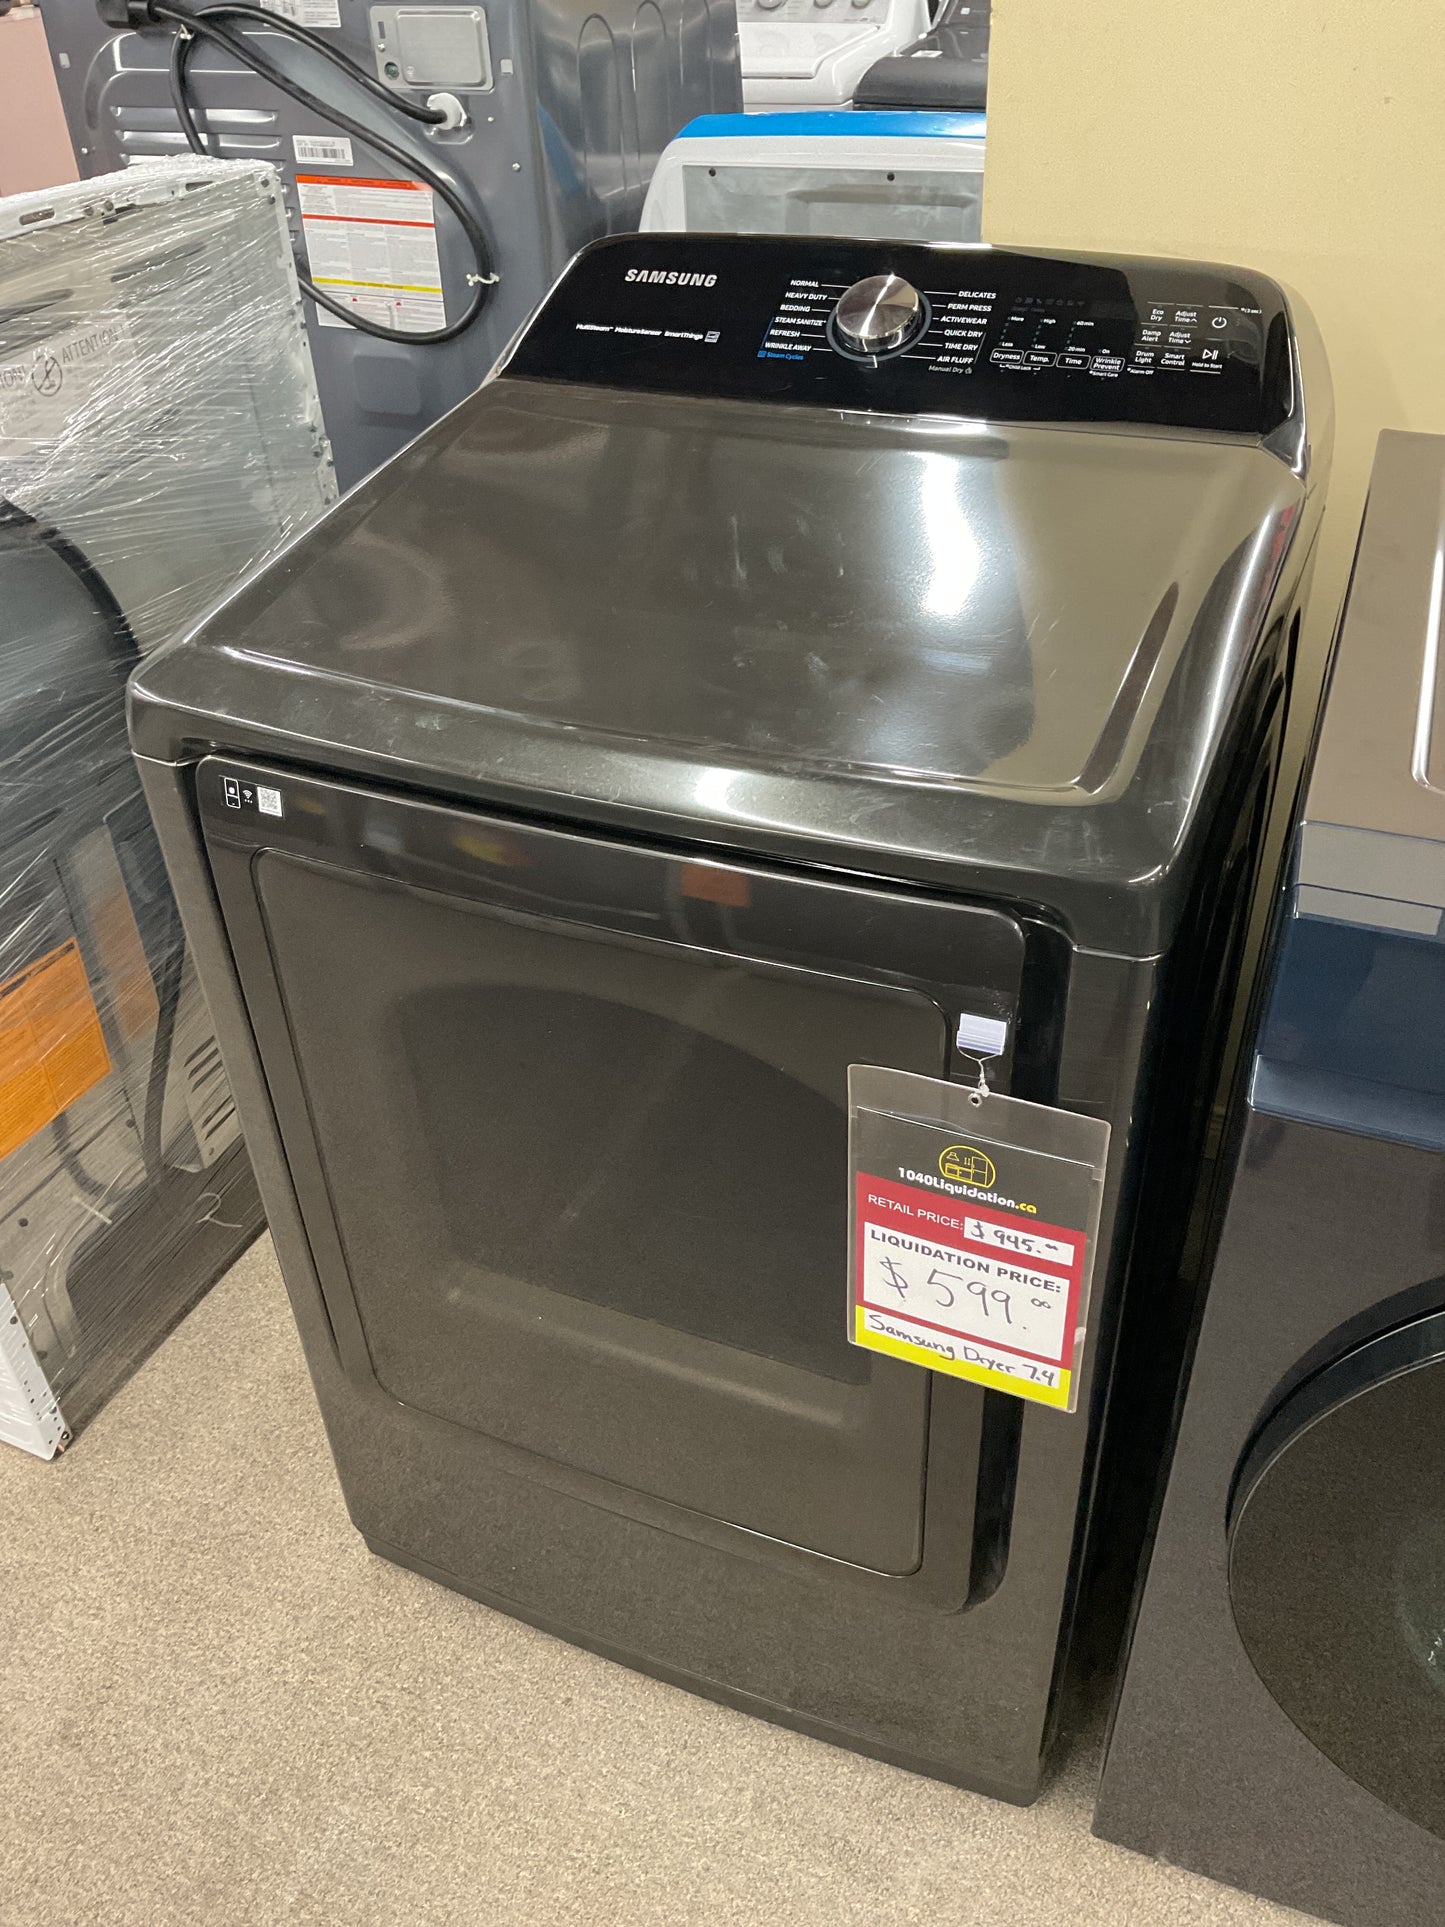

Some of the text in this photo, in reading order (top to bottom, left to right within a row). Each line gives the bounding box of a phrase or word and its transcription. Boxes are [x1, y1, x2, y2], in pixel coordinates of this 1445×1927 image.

[624, 268, 718, 287] SAMSUNG
[790, 280, 819, 288] NORMAL
[958, 291, 997, 299] DELICATES
[780, 304, 811, 312] BEDDING
[1175, 310, 1197, 318] Adjust
[774, 316, 796, 324] STEAM
[940, 315, 988, 325] ACTIVEWEAR
[664, 331, 704, 341] SmartThings
[769, 329, 801, 337] REFRESH
[944, 329, 984, 338] QUICK DRY
[1142, 329, 1162, 337] Damp
[765, 341, 812, 352] WRINKLE AWAY
[944, 342, 979, 351] TIME DRY
[767, 351, 786, 359] Steam
[993, 352, 1021, 362] Dryness
[1030, 355, 1050, 363] Temp.
[1164, 352, 1185, 360] Smart
[950, 356, 974, 364] FLUFF
[1065, 357, 1082, 365] Time
[1095, 357, 1122, 365] Wrinkle
[1135, 356, 1152, 364] Light
[951, 366, 964, 374] Dry
[1093, 362, 1120, 371] Prevent
[898, 1167, 1037, 1215] 1040Liquidation.ca
[868, 1194, 914, 1216] RETAIL
[917, 1208, 963, 1231] PRICE:
[971, 1221, 985, 1240] $
[871, 1229, 1061, 1293] LIQUIDATION PRICE:
[880, 1256, 909, 1299] $
[869, 1314, 1055, 1387] Samsung Dryer 7.4
